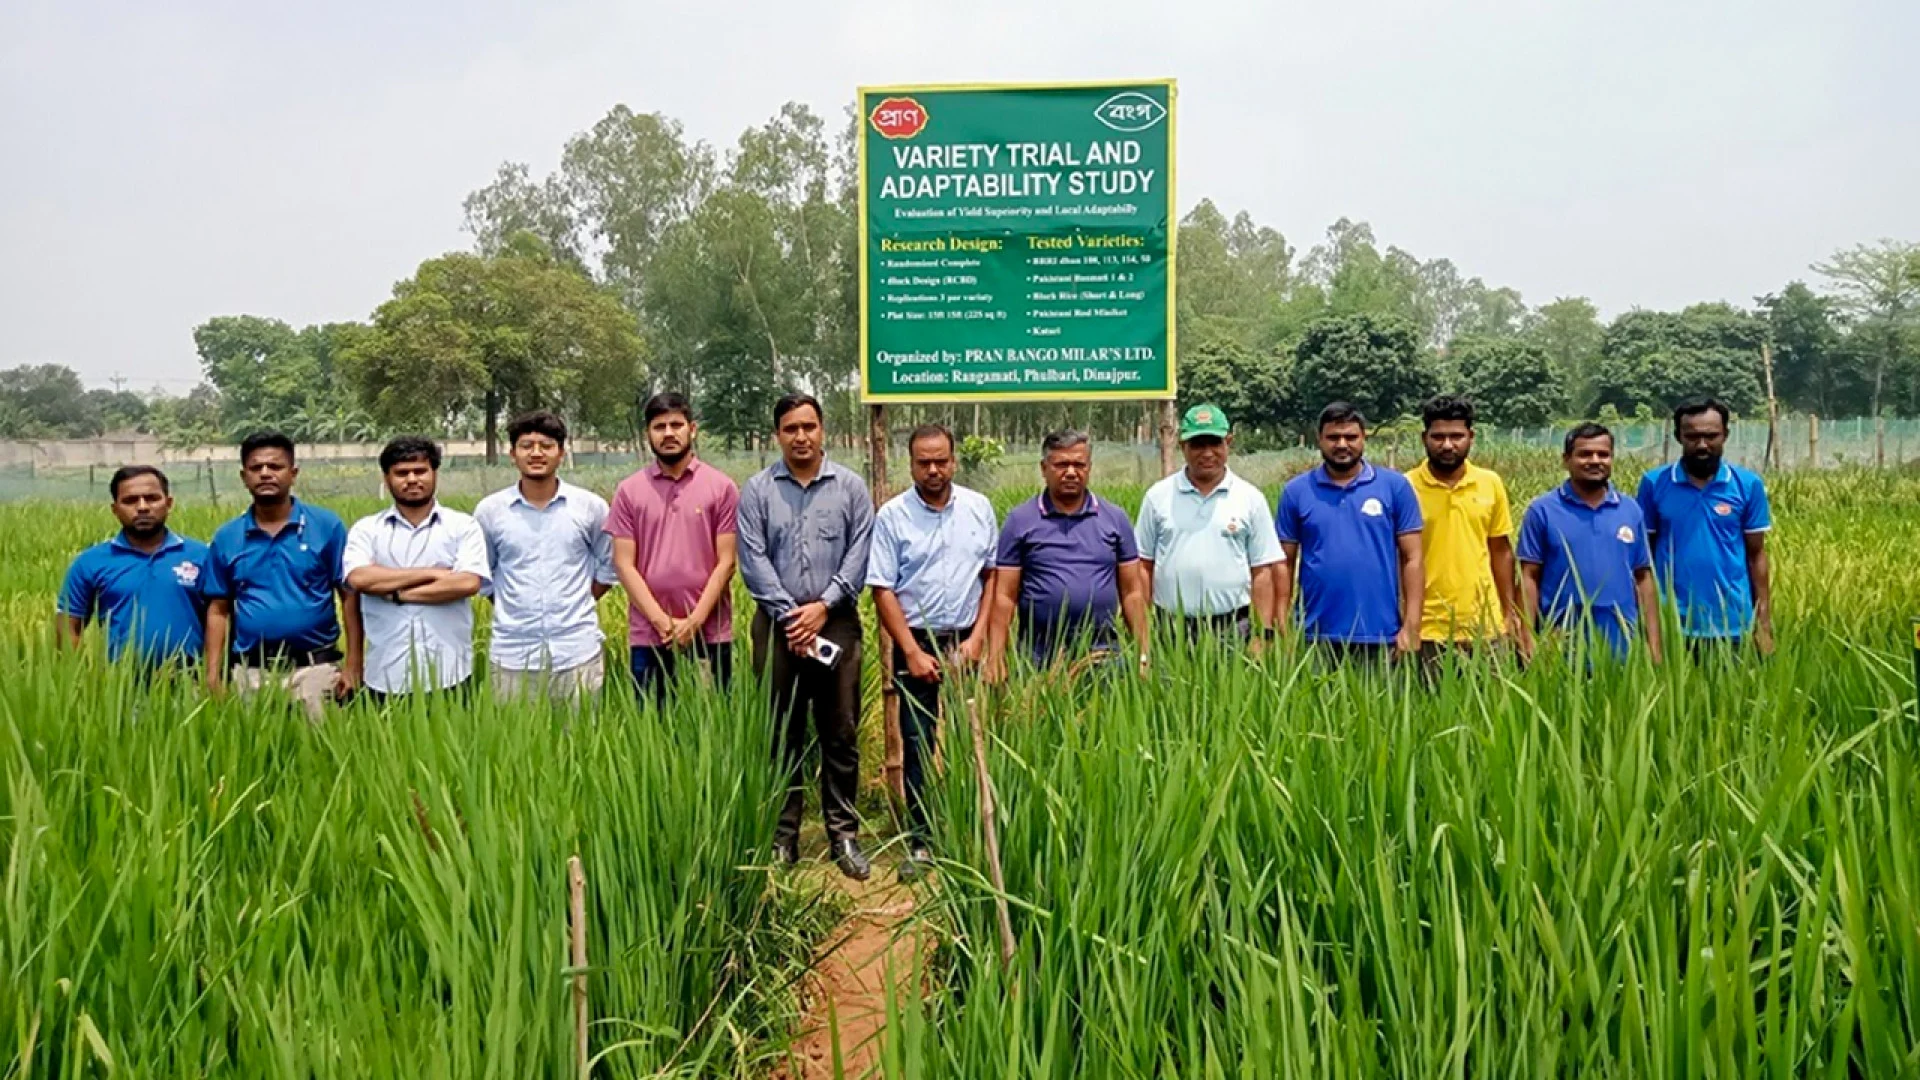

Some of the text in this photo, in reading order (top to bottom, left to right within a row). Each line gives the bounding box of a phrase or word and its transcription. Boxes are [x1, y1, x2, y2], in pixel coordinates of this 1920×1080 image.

[877, 108, 919, 127] প্রাণ
[893, 140, 1141, 169] VARIETY TRIAL AND
[879, 169, 1155, 199] ADAPTABILITY STUDY
[894, 207, 945, 218] Evaluation
[946, 206, 958, 217] of
[1034, 205, 1053, 215] and
[1055, 204, 1082, 215] Local
[881, 236, 1003, 253] Research Design:
[1026, 234, 1145, 249] Tested Varieties:
[940, 258, 981, 268] Complete
[912, 276, 941, 286] Design
[942, 275, 978, 285] (RCBD)
[1117, 273, 1127, 282] &
[947, 295, 961, 303] per
[1108, 290, 1118, 299] &
[887, 311, 904, 319] Plot
[876, 346, 1156, 366] Organized by: PRAN BANGO MILAR'S LTD.
[891, 367, 1142, 385] Location: Rangamati, Phulbari, Dinajpur.
